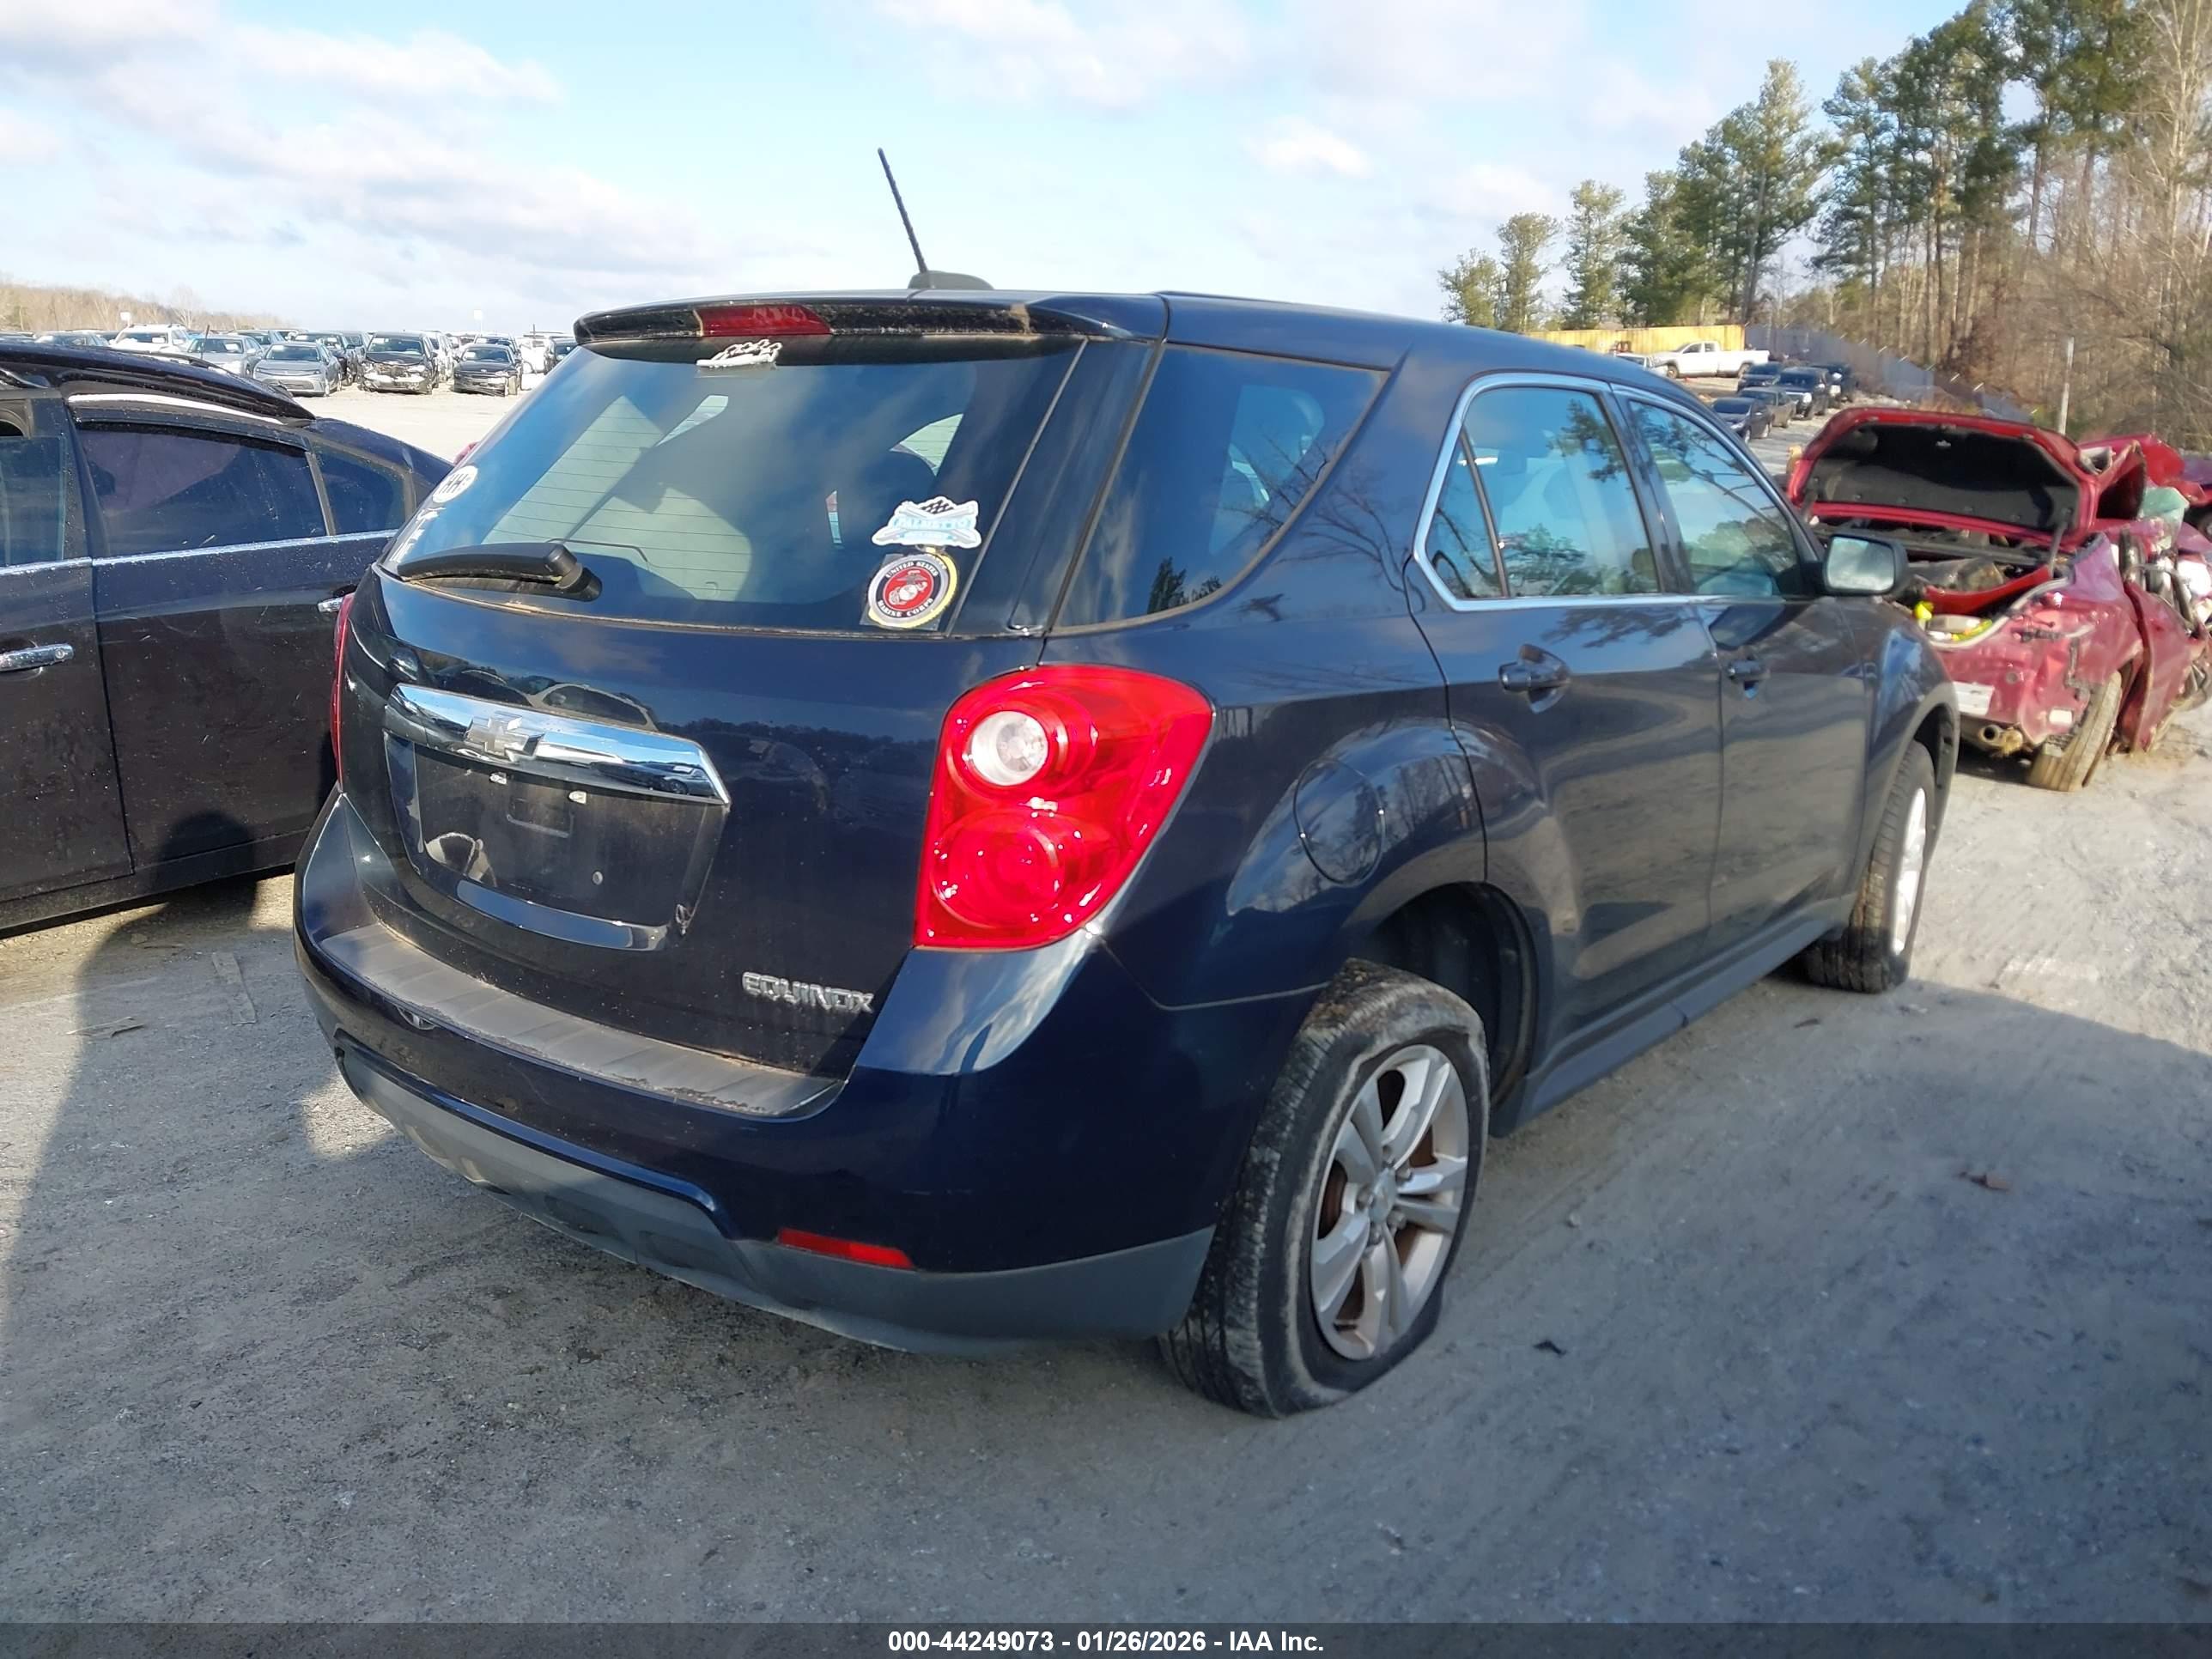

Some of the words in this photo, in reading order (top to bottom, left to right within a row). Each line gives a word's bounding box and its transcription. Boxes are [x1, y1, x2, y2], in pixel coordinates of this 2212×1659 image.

[885, 561, 915, 578] UNITED
[915, 561, 939, 577] STATES
[878, 599, 903, 617] MARINE
[906, 598, 934, 617] CORPS
[742, 971, 874, 1013] EQUINOX
